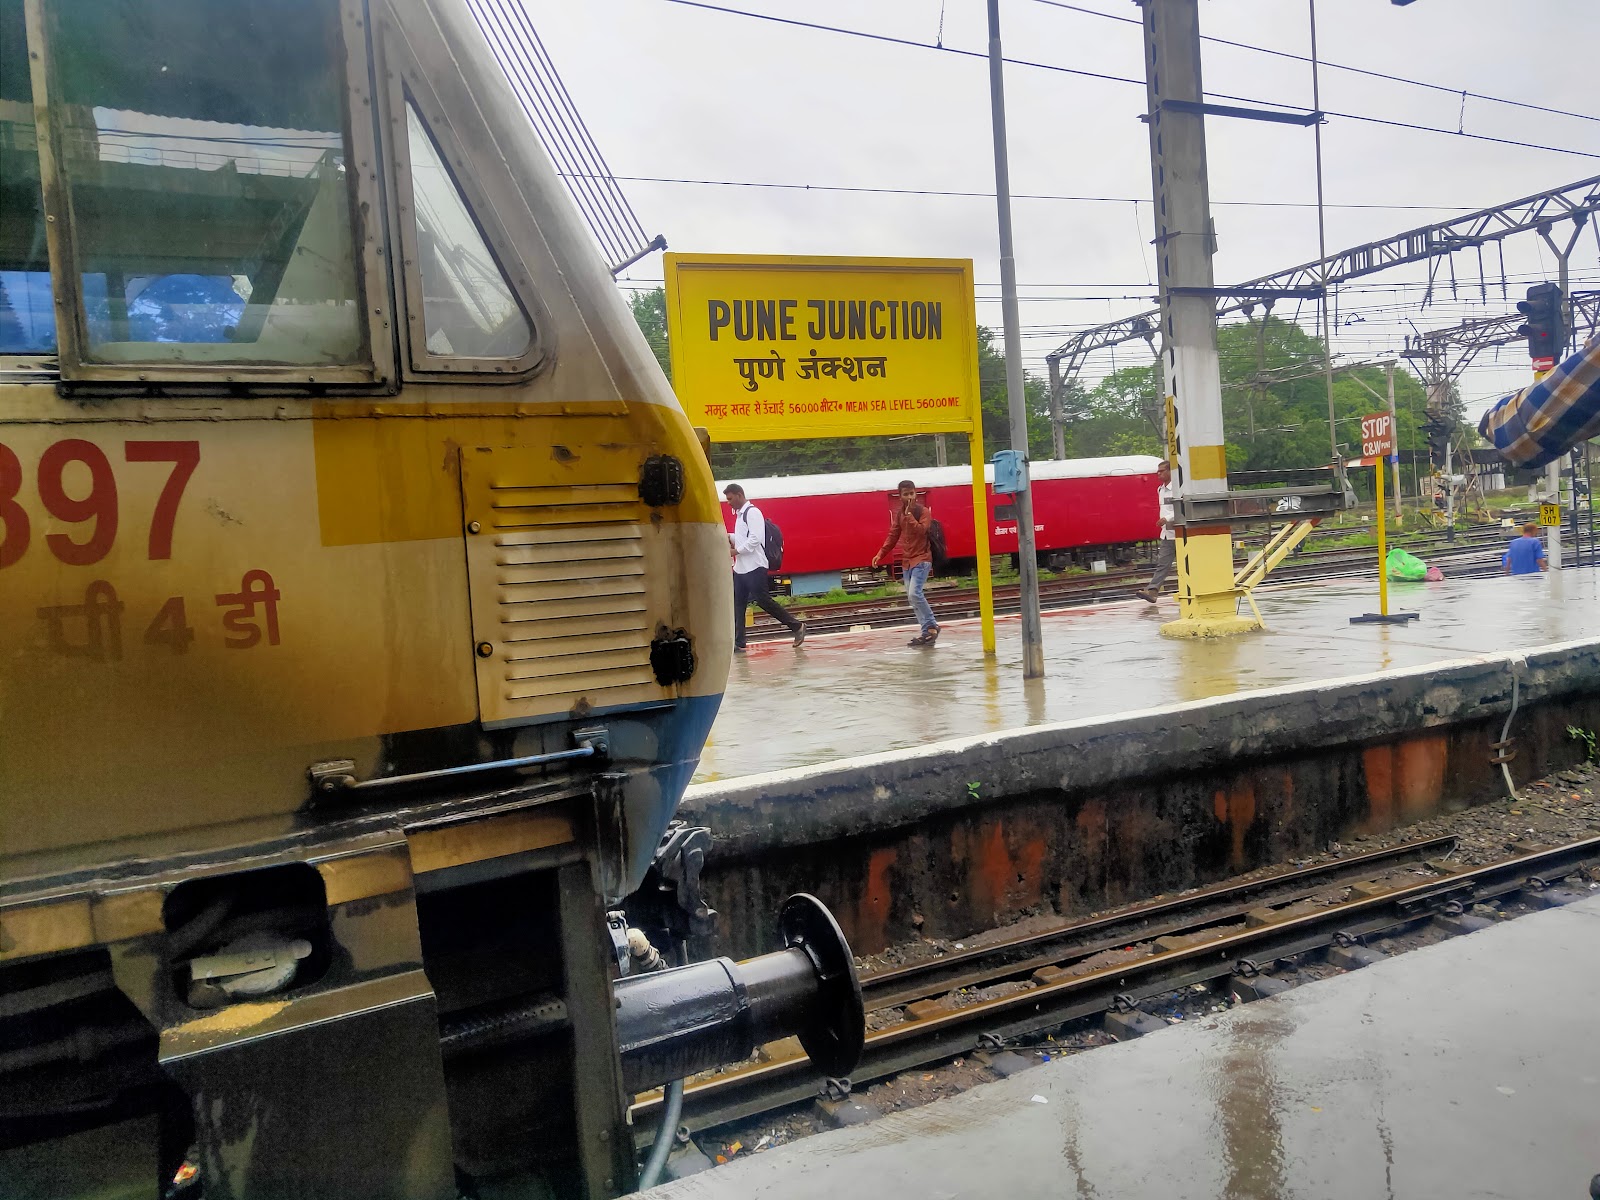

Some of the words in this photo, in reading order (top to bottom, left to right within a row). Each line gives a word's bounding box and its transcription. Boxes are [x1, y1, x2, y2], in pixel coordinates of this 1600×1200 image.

[707, 299, 798, 342] PUNE
[806, 299, 942, 341] JUNCTION
[732, 349, 786, 393] पुणे
[795, 348, 888, 382] जंक्शन
[730, 403, 751, 416] सतह
[845, 401, 869, 413] MEAN
[870, 400, 887, 412] SEA
[889, 399, 915, 411] LEVEL
[1361, 415, 1390, 439] STOP
[1362, 440, 1382, 456] C&W
[1543, 506, 1555, 515] SH
[1543, 516, 1557, 524] 107
[143, 596, 196, 655] 4
[214, 569, 281, 649] डी
